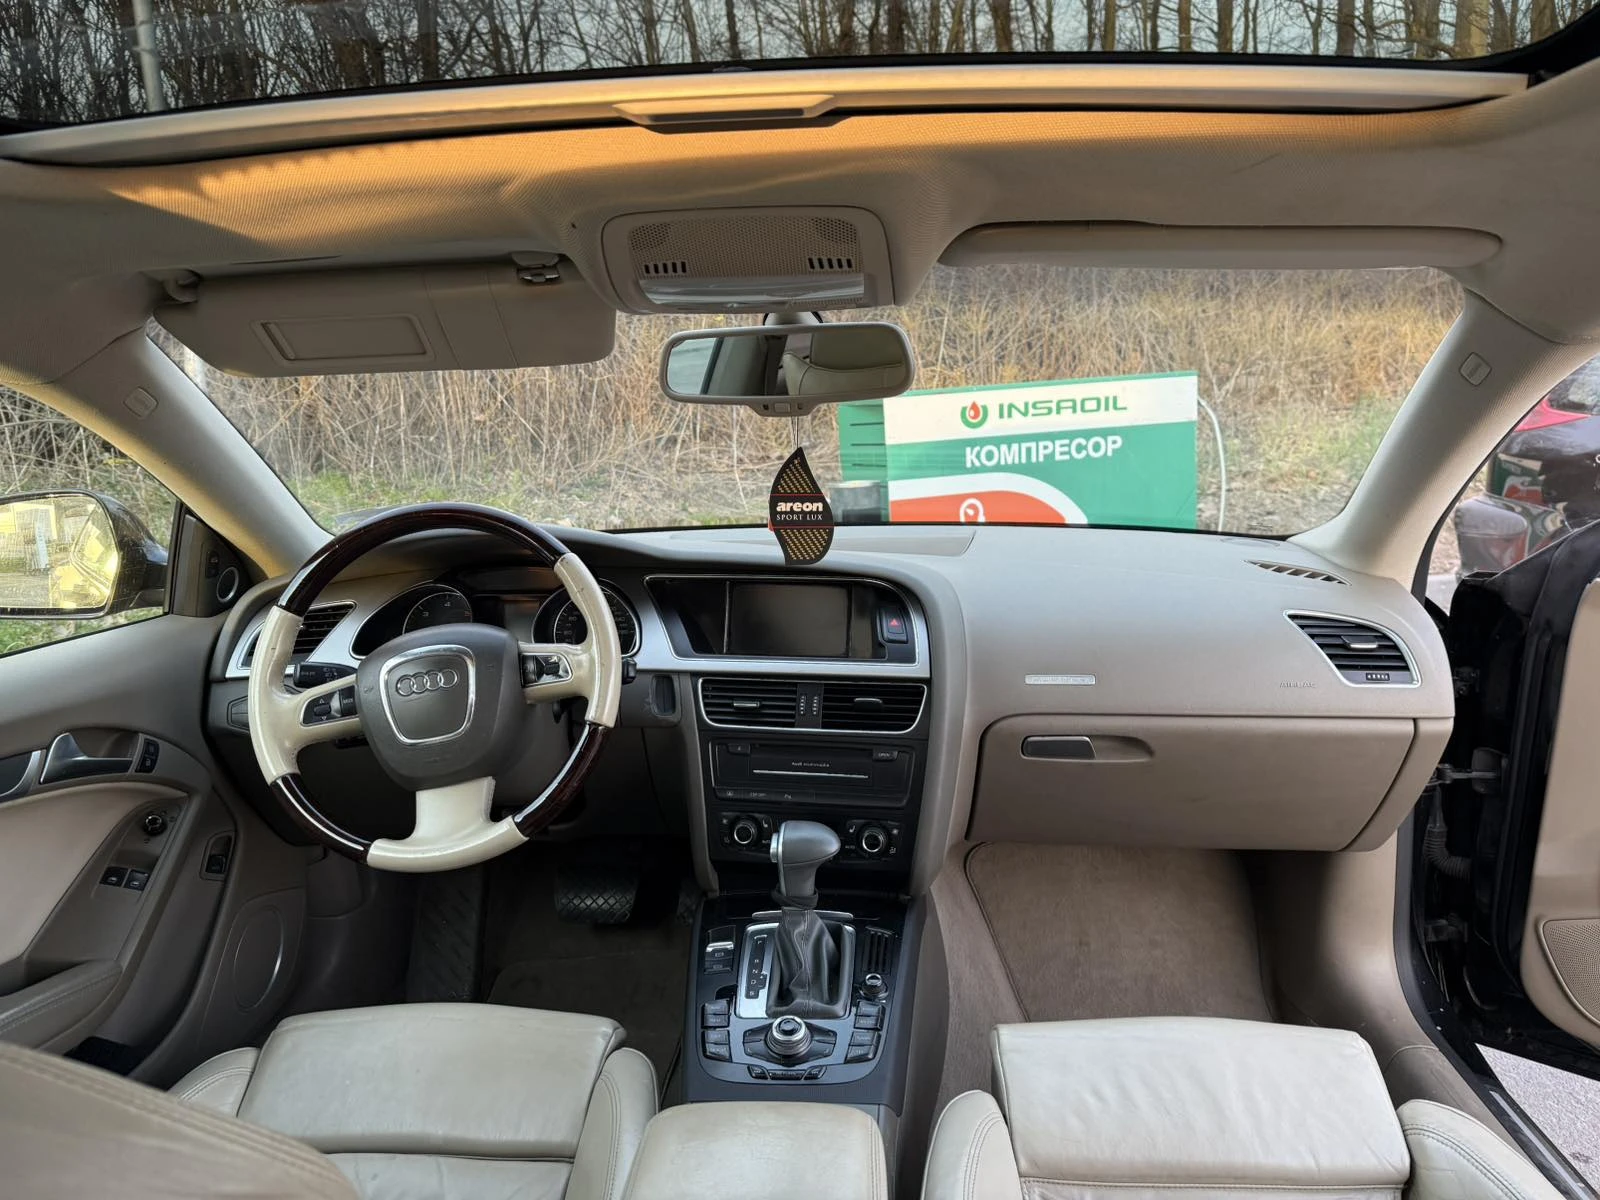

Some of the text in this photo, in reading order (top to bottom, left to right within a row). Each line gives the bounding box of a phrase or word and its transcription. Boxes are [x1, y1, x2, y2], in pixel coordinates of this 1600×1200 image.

[998, 395, 1128, 419] INSAOIL
[965, 435, 1123, 468] КОМПРЕСОР
[776, 502, 823, 512] areon
